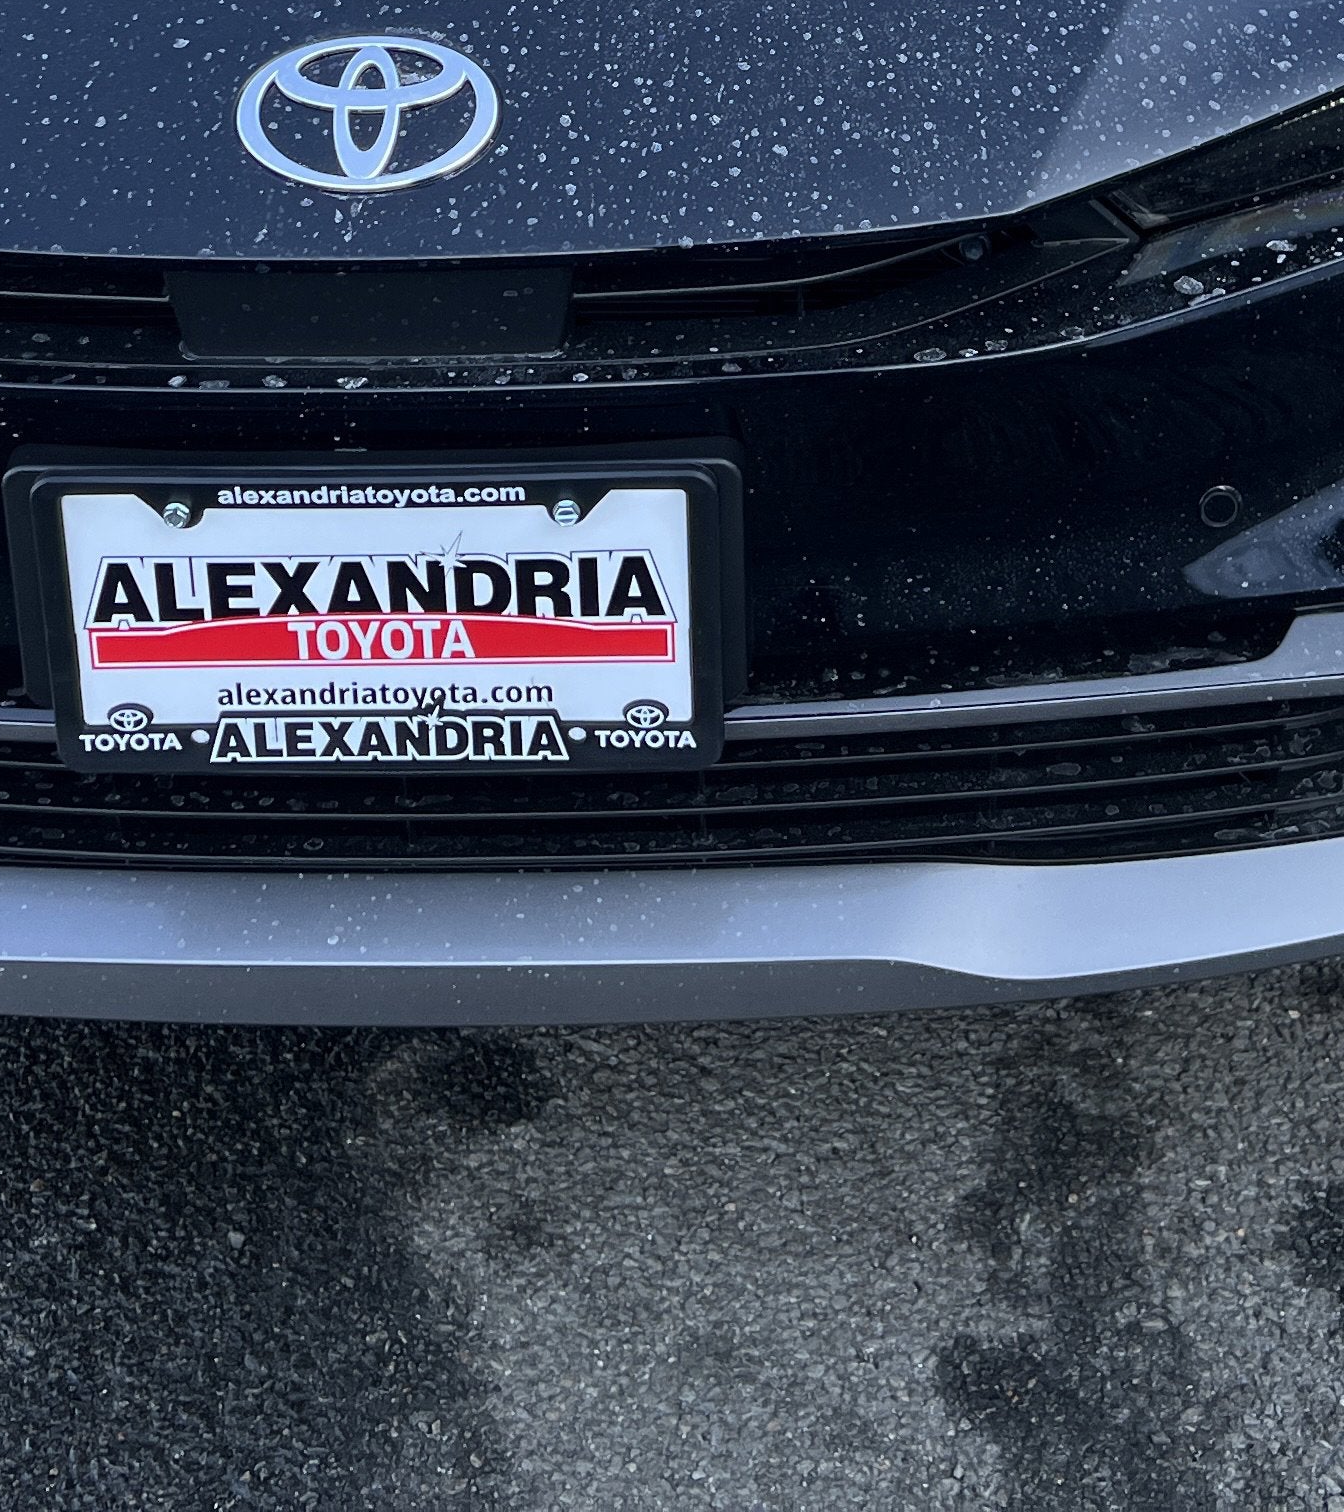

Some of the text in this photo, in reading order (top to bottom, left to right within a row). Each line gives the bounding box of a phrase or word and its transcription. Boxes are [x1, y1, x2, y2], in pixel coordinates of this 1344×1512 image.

[217, 485, 526, 508] alexandriatoyota.com
[88, 552, 670, 626] ALEXANDRIA
[287, 619, 477, 661] TOYOTA
[217, 681, 554, 709] alexandriatoyota.com
[78, 714, 698, 763] TOYOTA ALEXANDRIA TOYOTA
